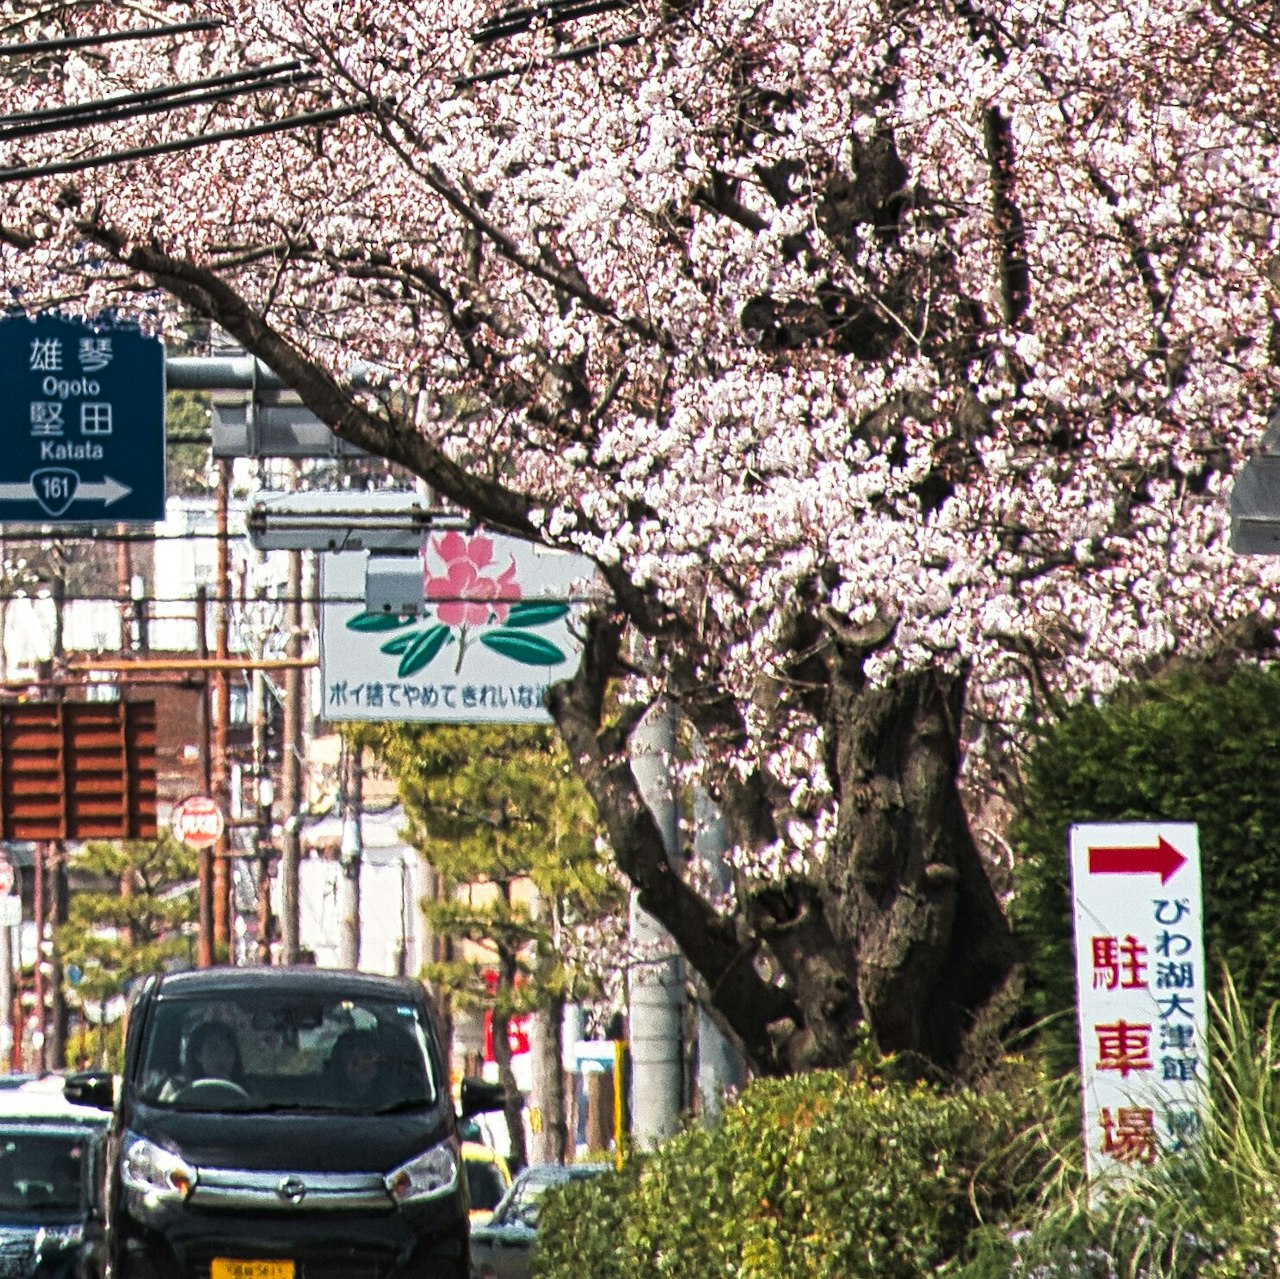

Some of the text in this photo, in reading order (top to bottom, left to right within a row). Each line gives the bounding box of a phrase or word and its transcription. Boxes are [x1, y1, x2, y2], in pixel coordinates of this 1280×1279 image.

[30, 337, 113, 372] 雄琴
[42, 376, 100, 398] Ogoto
[30, 401, 112, 436] 堅田
[41, 440, 103, 460] Katata
[42, 477, 68, 499] 161
[1152, 897, 1198, 1082] びわ湖大津館
[1091, 934, 1157, 1166] 駐車場
